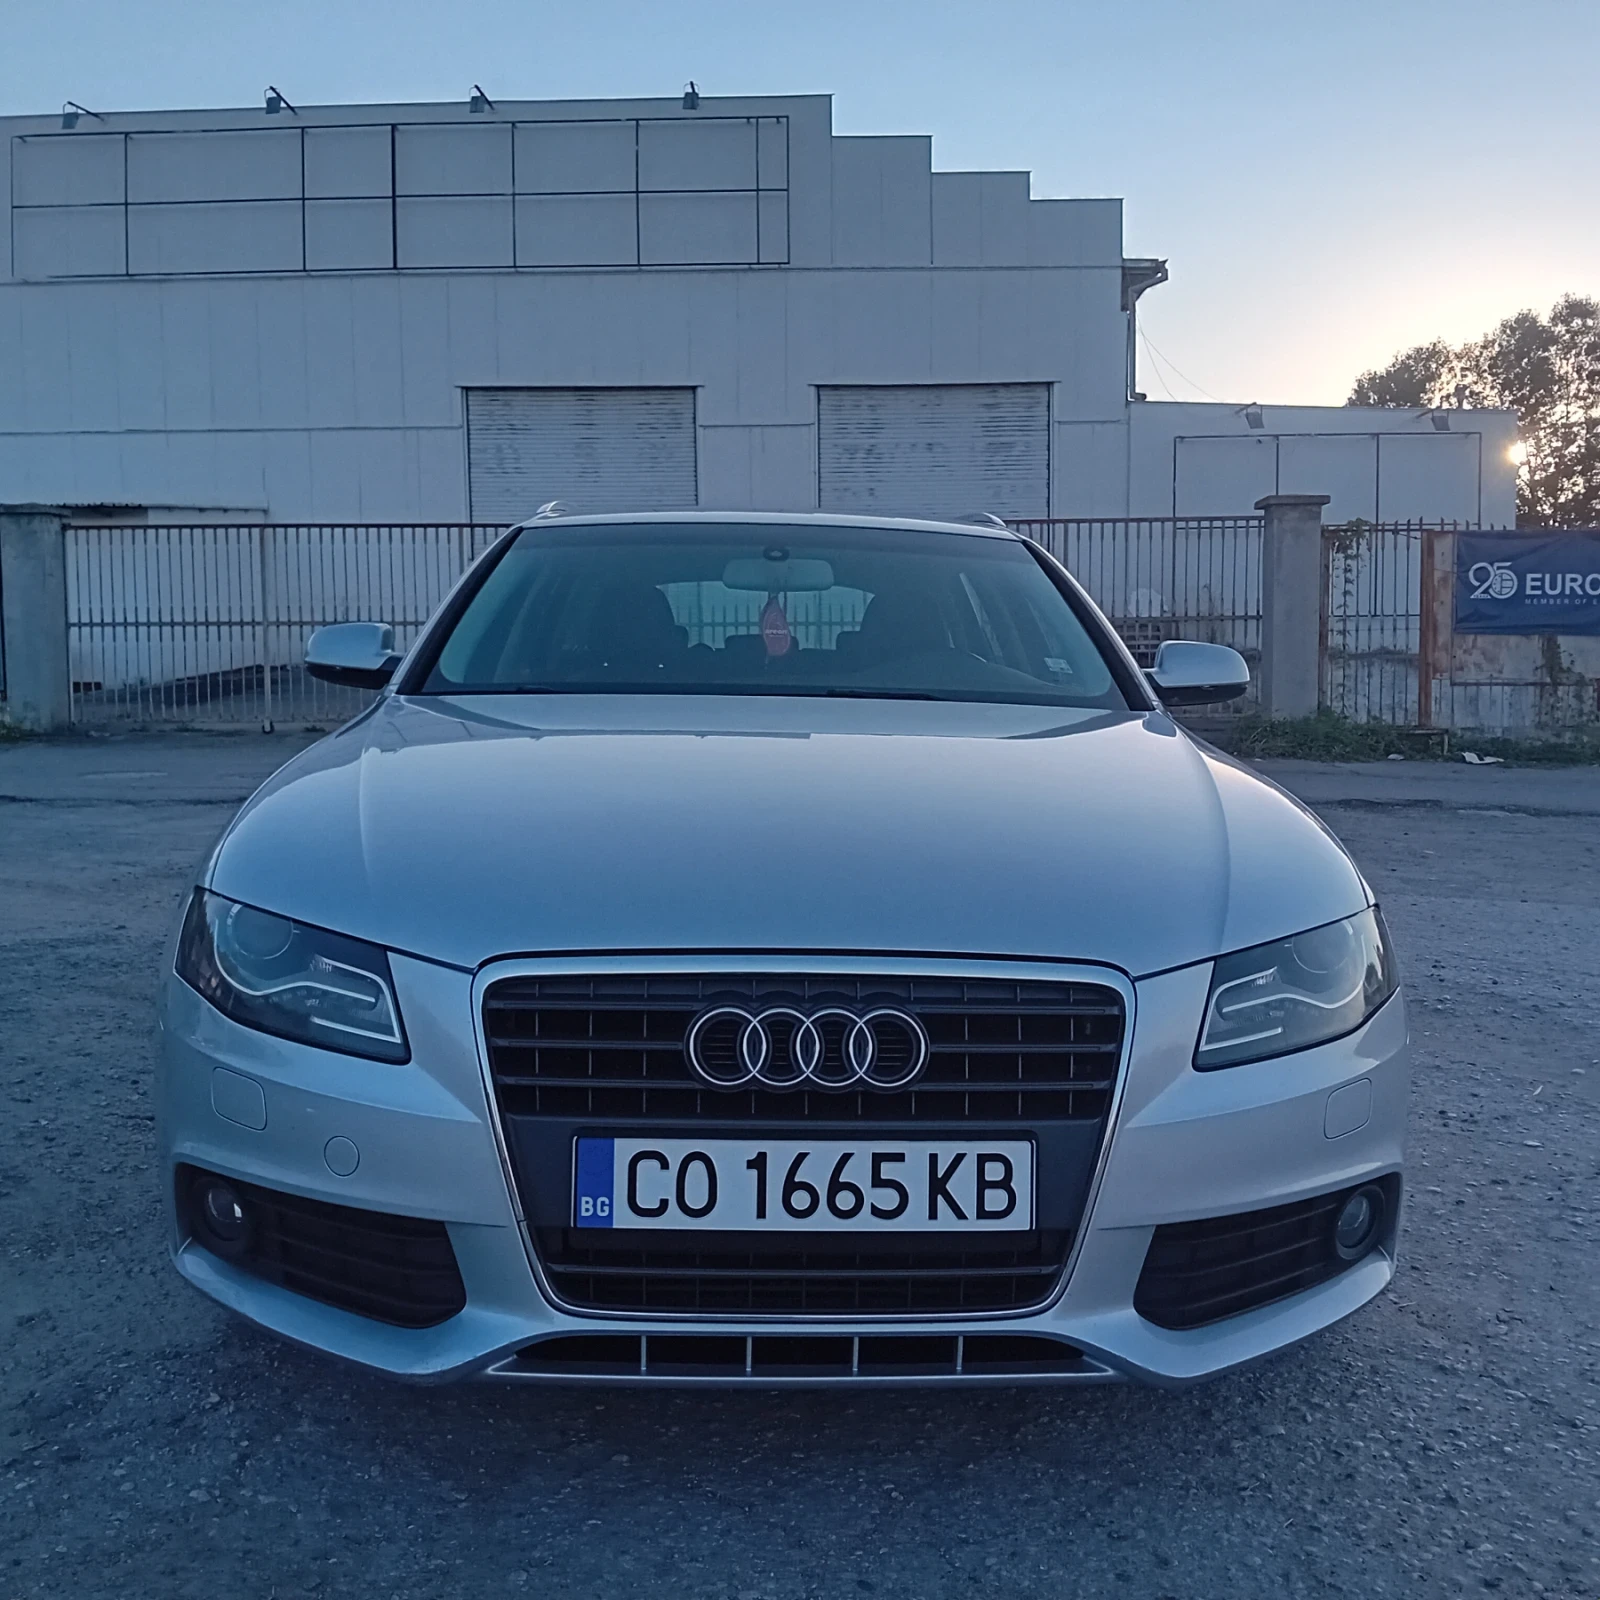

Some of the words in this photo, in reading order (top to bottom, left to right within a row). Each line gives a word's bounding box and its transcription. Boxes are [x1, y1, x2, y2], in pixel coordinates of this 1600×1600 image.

[1468, 562, 1518, 599] 25
[1525, 573, 1600, 595] EURO
[627, 1150, 718, 1219] CO
[746, 1151, 910, 1220] 1665
[928, 1152, 1017, 1221] KB
[580, 1196, 610, 1217] BG
